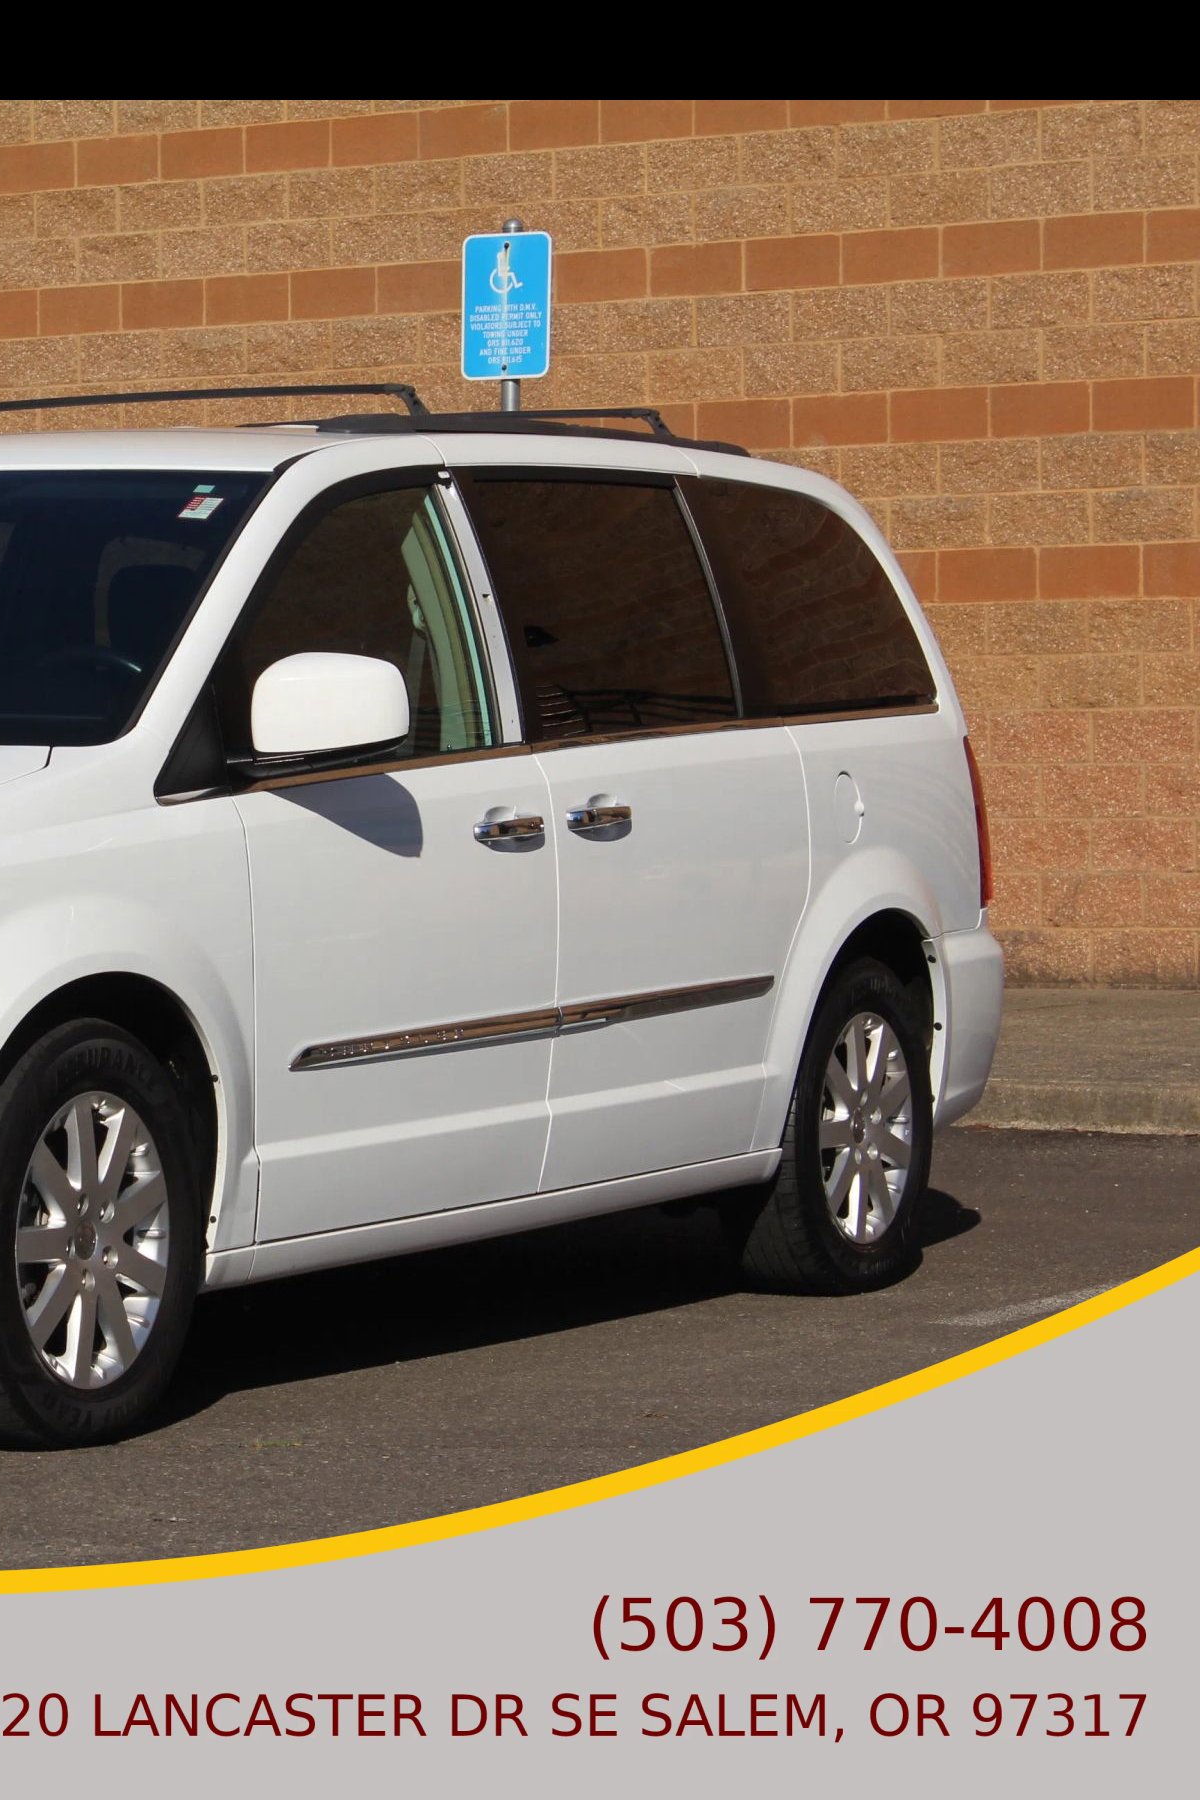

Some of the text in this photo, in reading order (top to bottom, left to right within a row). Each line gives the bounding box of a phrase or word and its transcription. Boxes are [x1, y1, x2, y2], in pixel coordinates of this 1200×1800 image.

[525, 311, 542, 319] ONLY
[533, 319, 541, 328] TO
[507, 329, 528, 337] UNDER
[509, 346, 531, 354] UNDER
